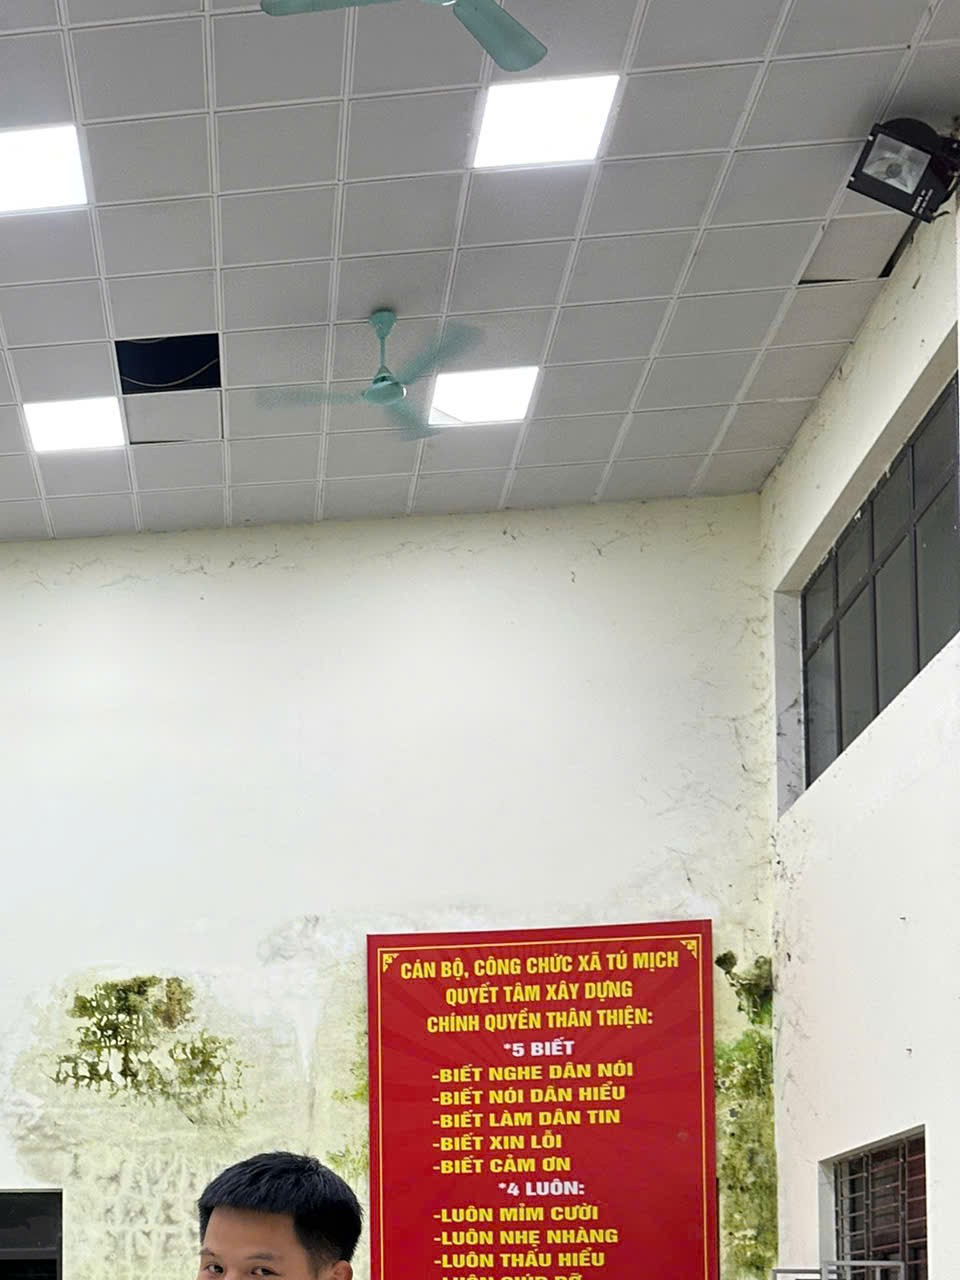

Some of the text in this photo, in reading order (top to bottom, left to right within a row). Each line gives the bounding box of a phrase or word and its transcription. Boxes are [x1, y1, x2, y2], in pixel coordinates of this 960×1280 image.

[401, 950, 678, 980] CÁN BỘ, CÔNG CHỨC XÃ TÚ MỊCH
[446, 980, 632, 1006] QUYẾT TÂM XÂY DỰNG
[427, 1005, 652, 1032] CHÍNH QUYỀN THÂN THIỆN:
[531, 1037, 574, 1056] BIẾT
[432, 1060, 633, 1082] -BIẾT NGHE DÂN NÓI
[432, 1081, 625, 1105] -BIẾT NÓI DÂN HIỂU
[433, 1108, 620, 1128] -BIẾT LÀM DÂN TIN
[433, 1130, 561, 1151] -BIẾT XIN LỖI
[433, 1154, 570, 1173] -BIẾT CẢM ƠN
[526, 1179, 584, 1195] LUÔN:
[434, 1206, 493, 1222] -LUÔN
[551, 1203, 598, 1220] CƯỜI
[434, 1227, 618, 1247] -LUÔN NHẸ NHÀNG
[435, 1245, 604, 1268] -LUÔN THẤU HIỂU
